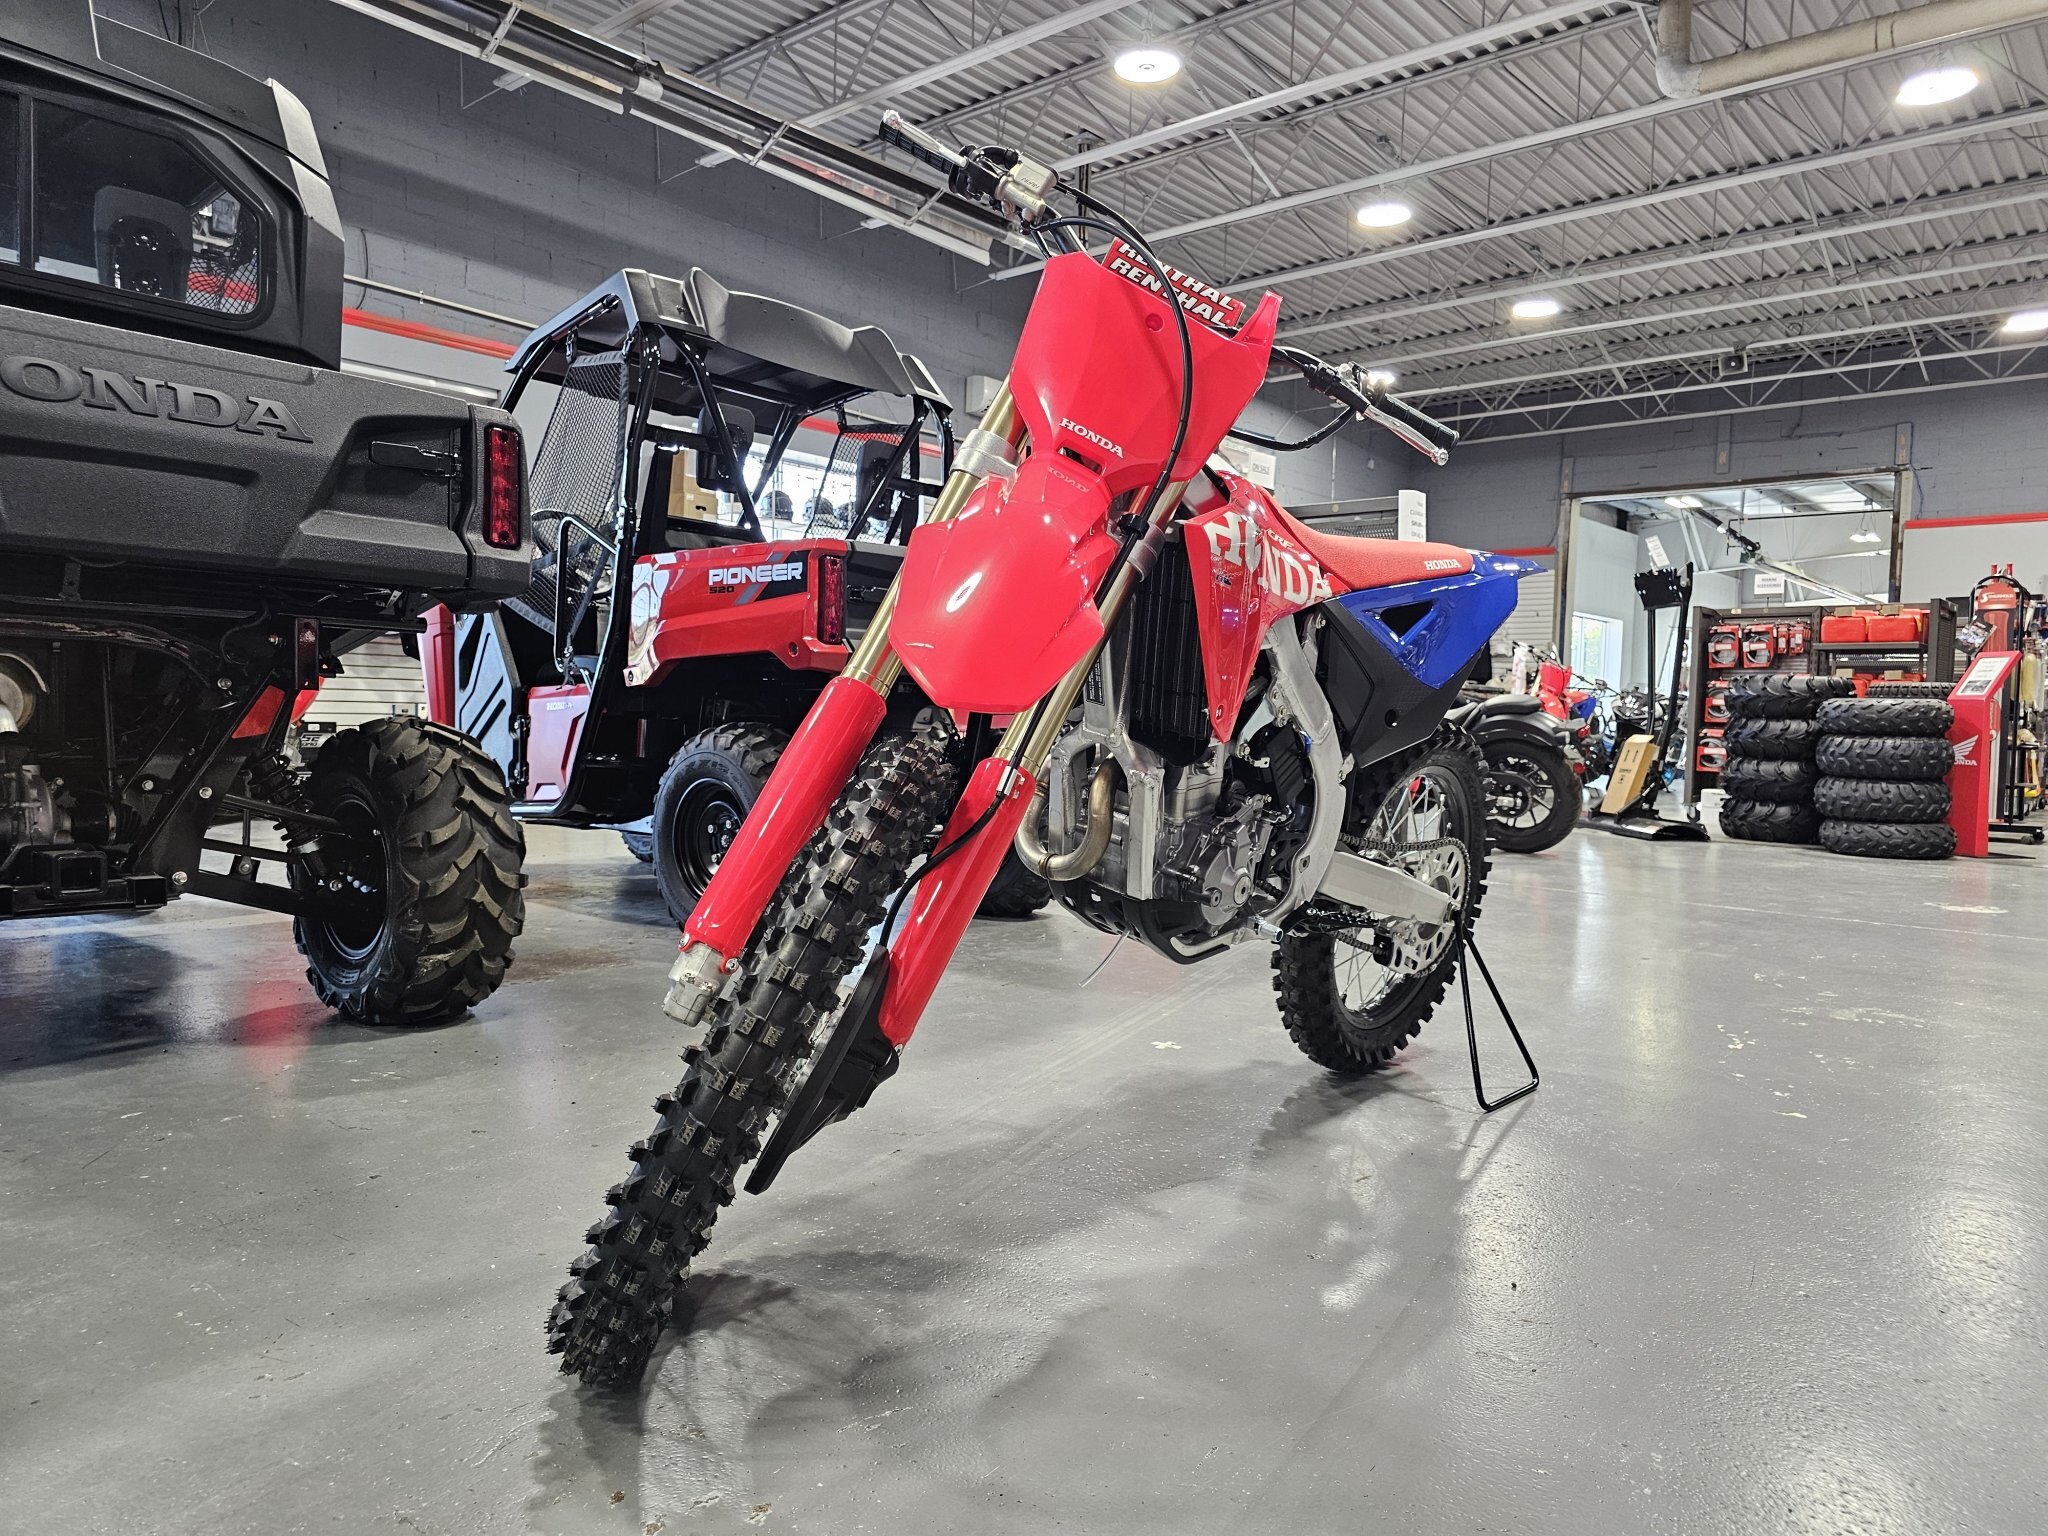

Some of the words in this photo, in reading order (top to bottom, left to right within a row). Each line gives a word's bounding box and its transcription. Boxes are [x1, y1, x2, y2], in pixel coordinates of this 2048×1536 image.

[1118, 243, 1234, 311] RTHAL
[0, 355, 313, 443] ONDA
[1059, 417, 1124, 459] HONDA
[708, 562, 803, 586] PIONEER
[1203, 511, 1333, 608] HONDA
[1424, 558, 1463, 570] HONDA
[709, 586, 734, 594] 520
[1953, 758, 1978, 767] ONDA
